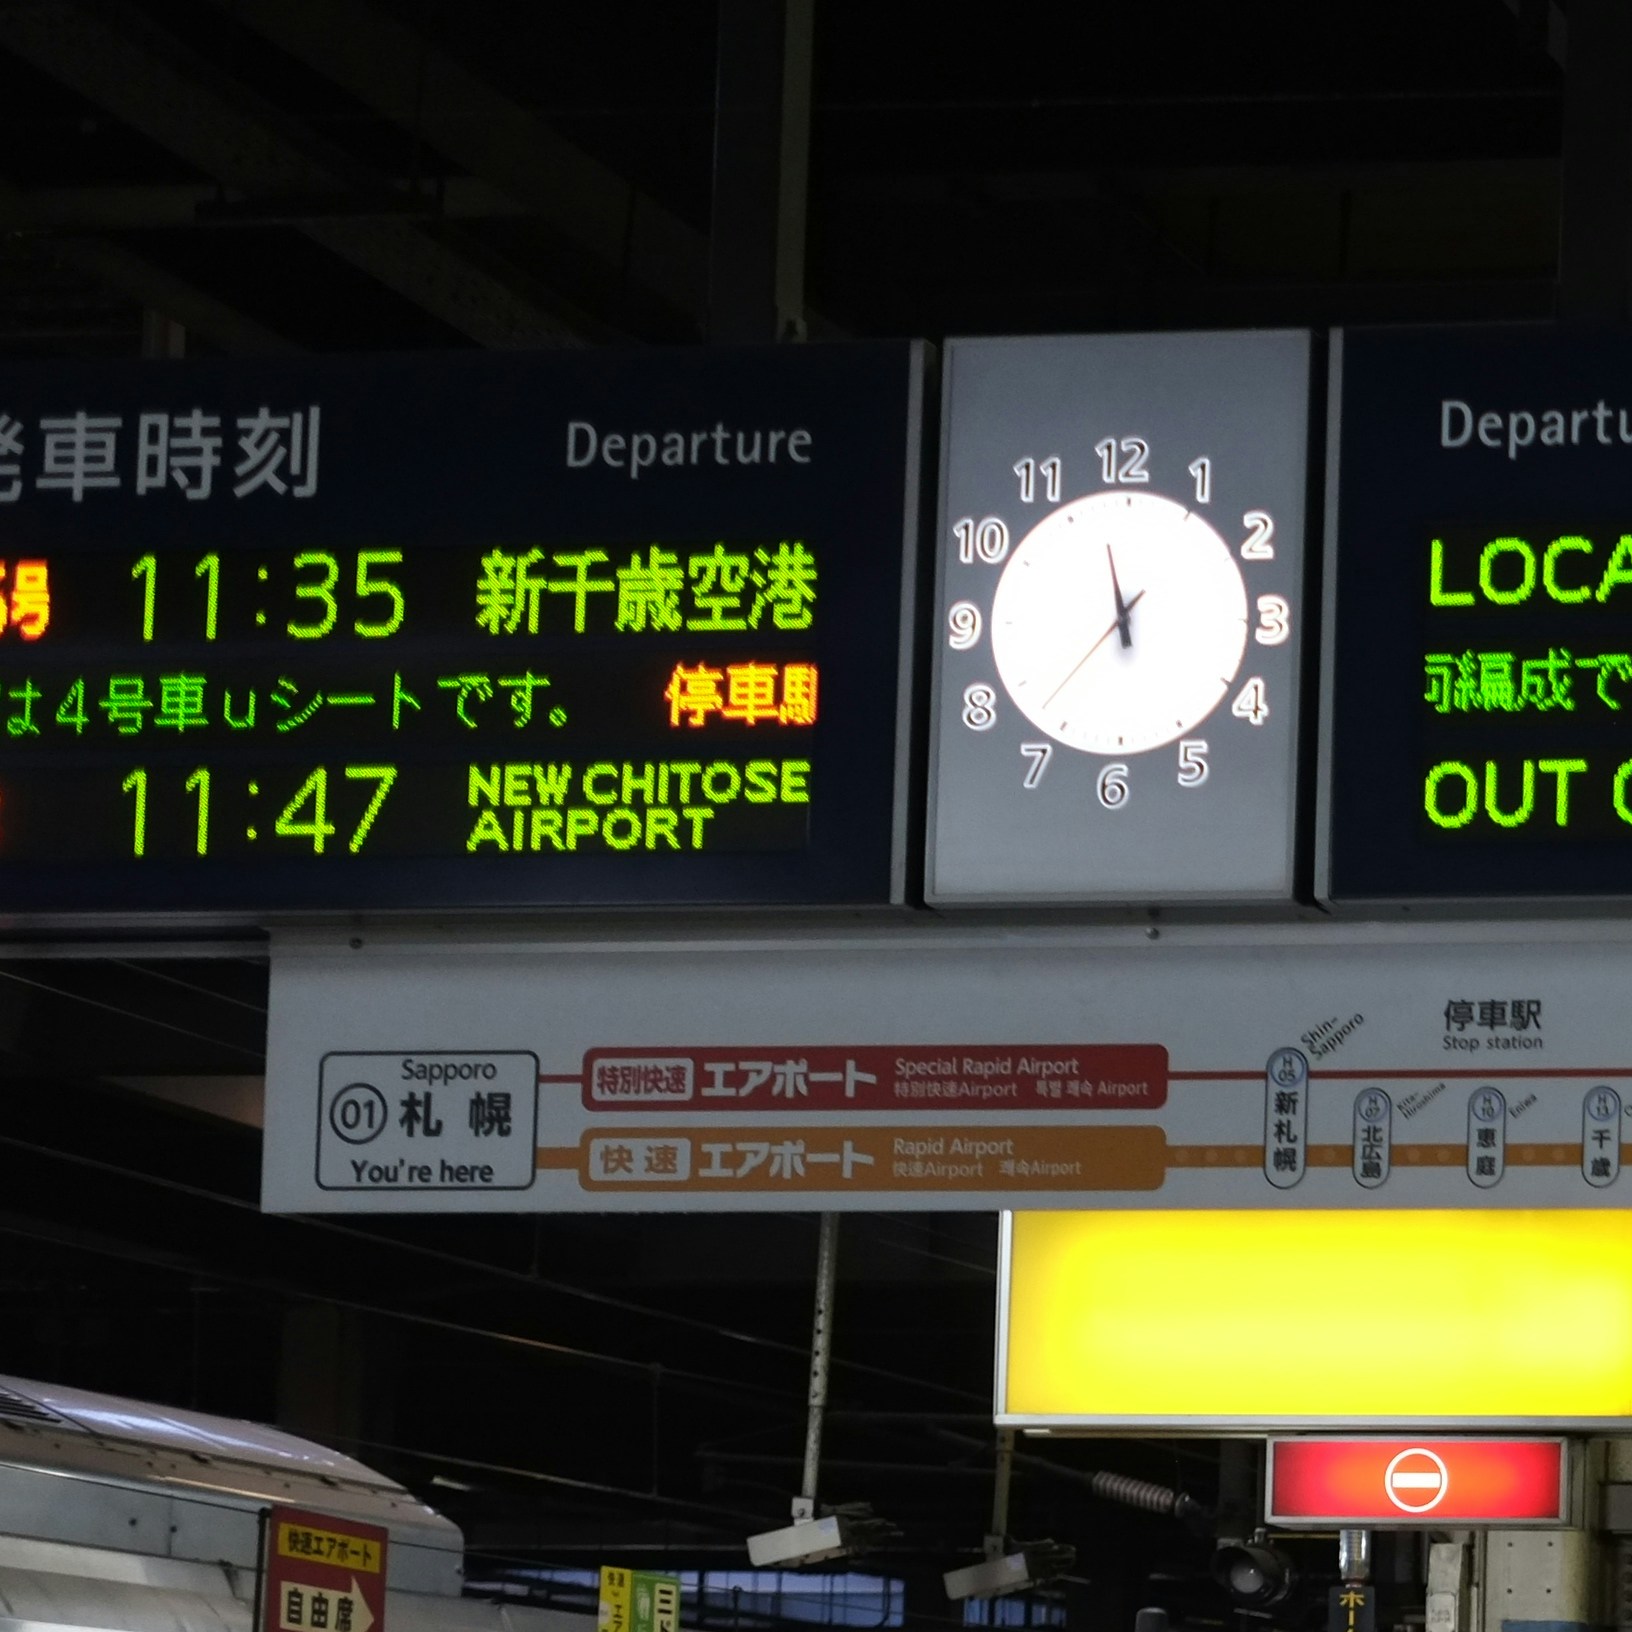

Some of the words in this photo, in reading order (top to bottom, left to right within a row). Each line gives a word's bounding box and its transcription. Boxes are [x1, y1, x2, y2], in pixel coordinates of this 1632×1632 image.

[0, 403, 322, 504] 車時刻
[566, 421, 814, 479] Departure
[1095, 437, 1149, 484] 12
[1014, 457, 1064, 504] 11
[1188, 457, 1212, 502] 1
[953, 515, 1010, 564] 10
[1242, 514, 1275, 561] 2
[130, 550, 406, 643] 11:35
[476, 541, 818, 635] 新千歳空港
[947, 601, 984, 651] 9
[1254, 601, 1291, 646] 3
[961, 684, 998, 732] 8
[1231, 676, 1269, 725] 4
[1020, 740, 1054, 789] 7
[1178, 740, 1211, 786] 5
[121, 765, 399, 857] 11:47
[467, 763, 572, 809] NEW
[582, 760, 811, 807] CHITOSE
[1096, 764, 1131, 811] 6
[1424, 758, 1587, 829] OUT
[467, 807, 716, 853] AIRPORT
[1299, 1012, 1341, 1049] Shin-
[1309, 1010, 1367, 1062] Sapporo
[1443, 998, 1543, 1033] 停車駅
[1281, 1054, 1292, 1067] H
[1442, 1033, 1482, 1054] Stop
[1486, 1032, 1545, 1051] station
[401, 1058, 498, 1086] Sapporo
[596, 1062, 690, 1097] 特別快速
[700, 1058, 879, 1099] エアポート
[894, 1057, 958, 1078] Special
[962, 1057, 1013, 1078] Rapid
[1016, 1057, 1080, 1079] Airport
[1096, 1079, 1150, 1098] Airport
[1277, 1066, 1298, 1083] 05
[340, 1100, 377, 1132] 01
[398, 1088, 513, 1140] 札幌
[1363, 1106, 1382, 1120] 07
[1367, 1096, 1378, 1107] H
[1480, 1105, 1496, 1118] 10
[1482, 1095, 1493, 1105] H
[1508, 1092, 1540, 1120] Eniwa
[1595, 1104, 1610, 1117] 13
[892, 1137, 944, 1158] Rapid
[949, 1137, 1015, 1159] Airport
[1272, 1089, 1300, 1175] 新札幌
[1360, 1123, 1384, 1182] 北広島
[1475, 1126, 1499, 1182] 恵庭
[1589, 1127, 1613, 1181] 千歳
[350, 1157, 431, 1187] You're
[438, 1158, 495, 1185] here
[599, 1142, 681, 1177] 快速
[697, 1139, 876, 1180] エアポート
[287, 1527, 374, 1569] 快速エアポート
